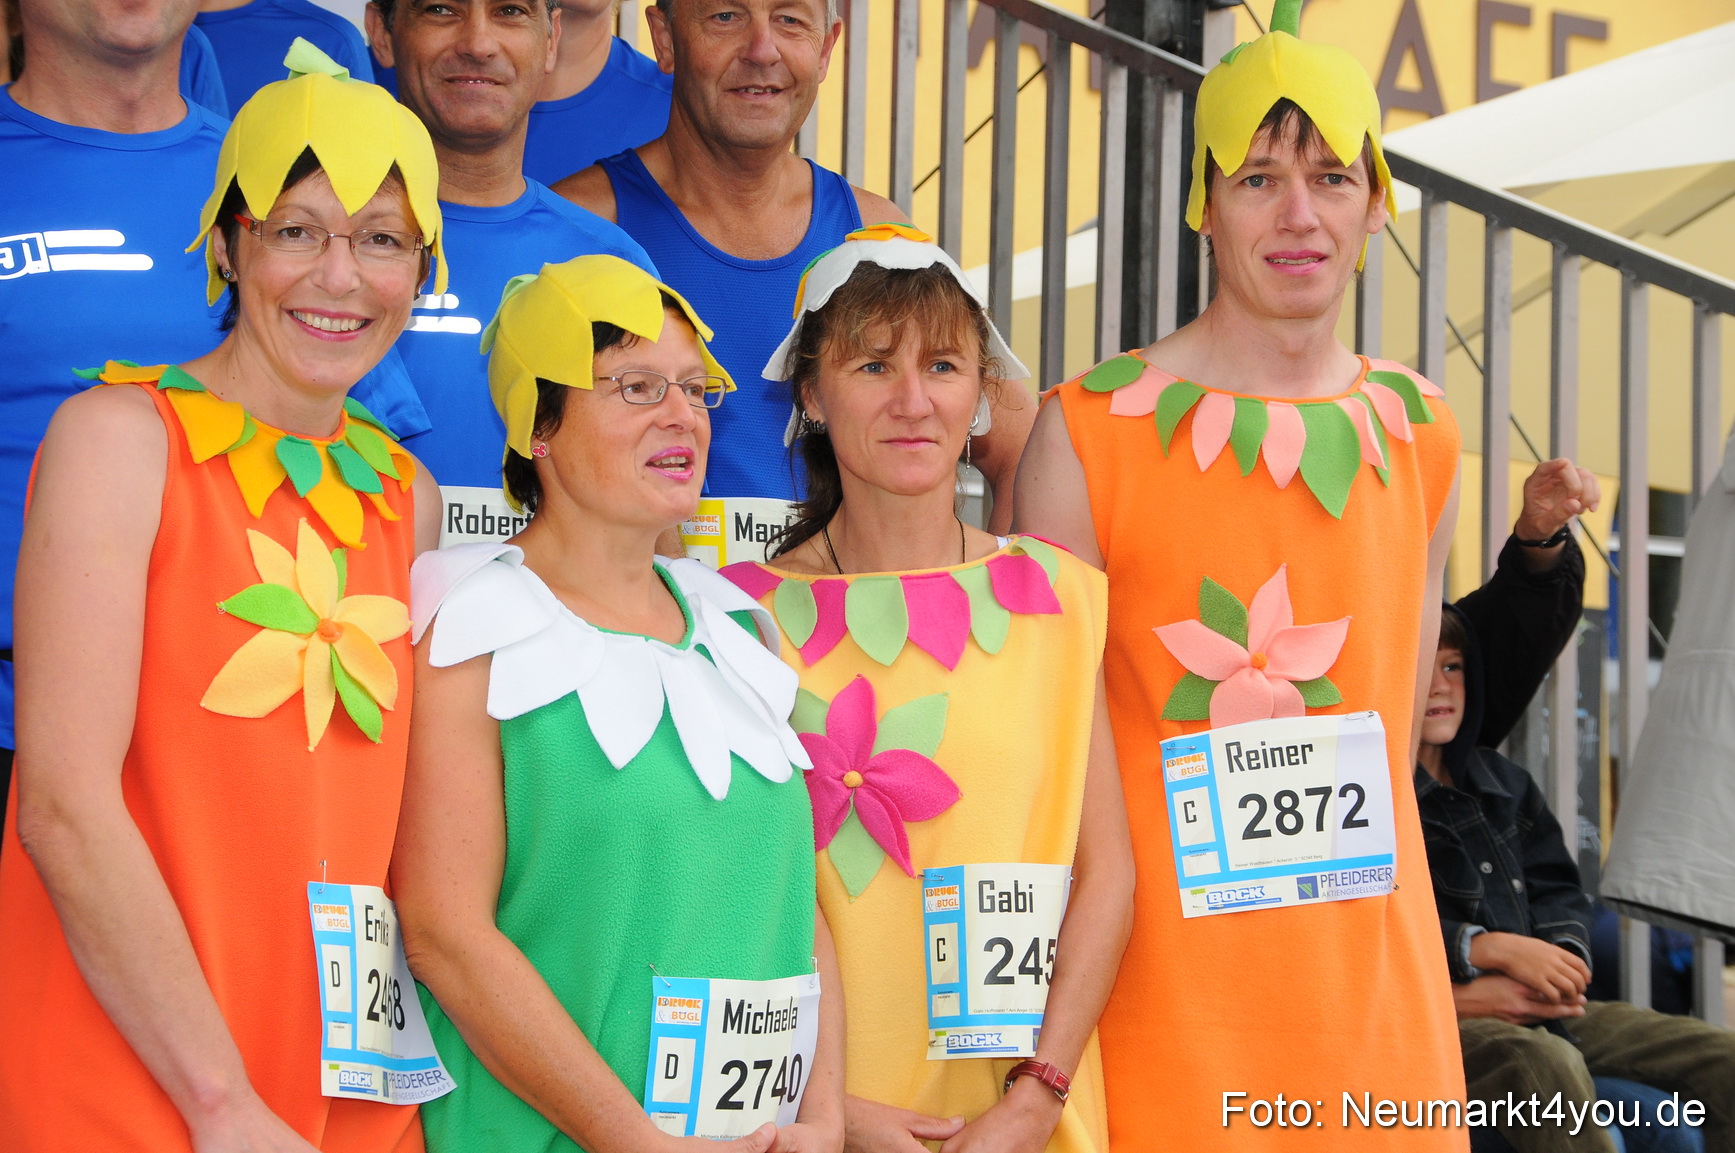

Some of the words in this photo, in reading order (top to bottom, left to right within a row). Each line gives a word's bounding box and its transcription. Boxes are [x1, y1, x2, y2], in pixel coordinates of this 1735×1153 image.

[1166, 753, 1206, 769] DRUCK
[1225, 741, 1314, 773] Reiner
[1183, 800, 1197, 824] C
[1238, 783, 1369, 841] 2872
[1320, 867, 1393, 888] PFLEIDERER
[925, 886, 959, 897] DRUCK
[978, 880, 1034, 913] Gabi
[1206, 885, 1266, 905] BOCK
[313, 904, 348, 916] DRUCK
[365, 904, 389, 947] Erika
[936, 938, 946, 962] C
[983, 936, 1057, 986] 245
[331, 961, 340, 987] D
[366, 968, 405, 1031] 2468
[657, 997, 702, 1009] DRUCK
[722, 996, 798, 1034] Michaela
[947, 1033, 1003, 1048] BOCK
[339, 1070, 373, 1087] BOCK
[665, 1054, 679, 1079] D
[715, 1053, 803, 1111] 2740
